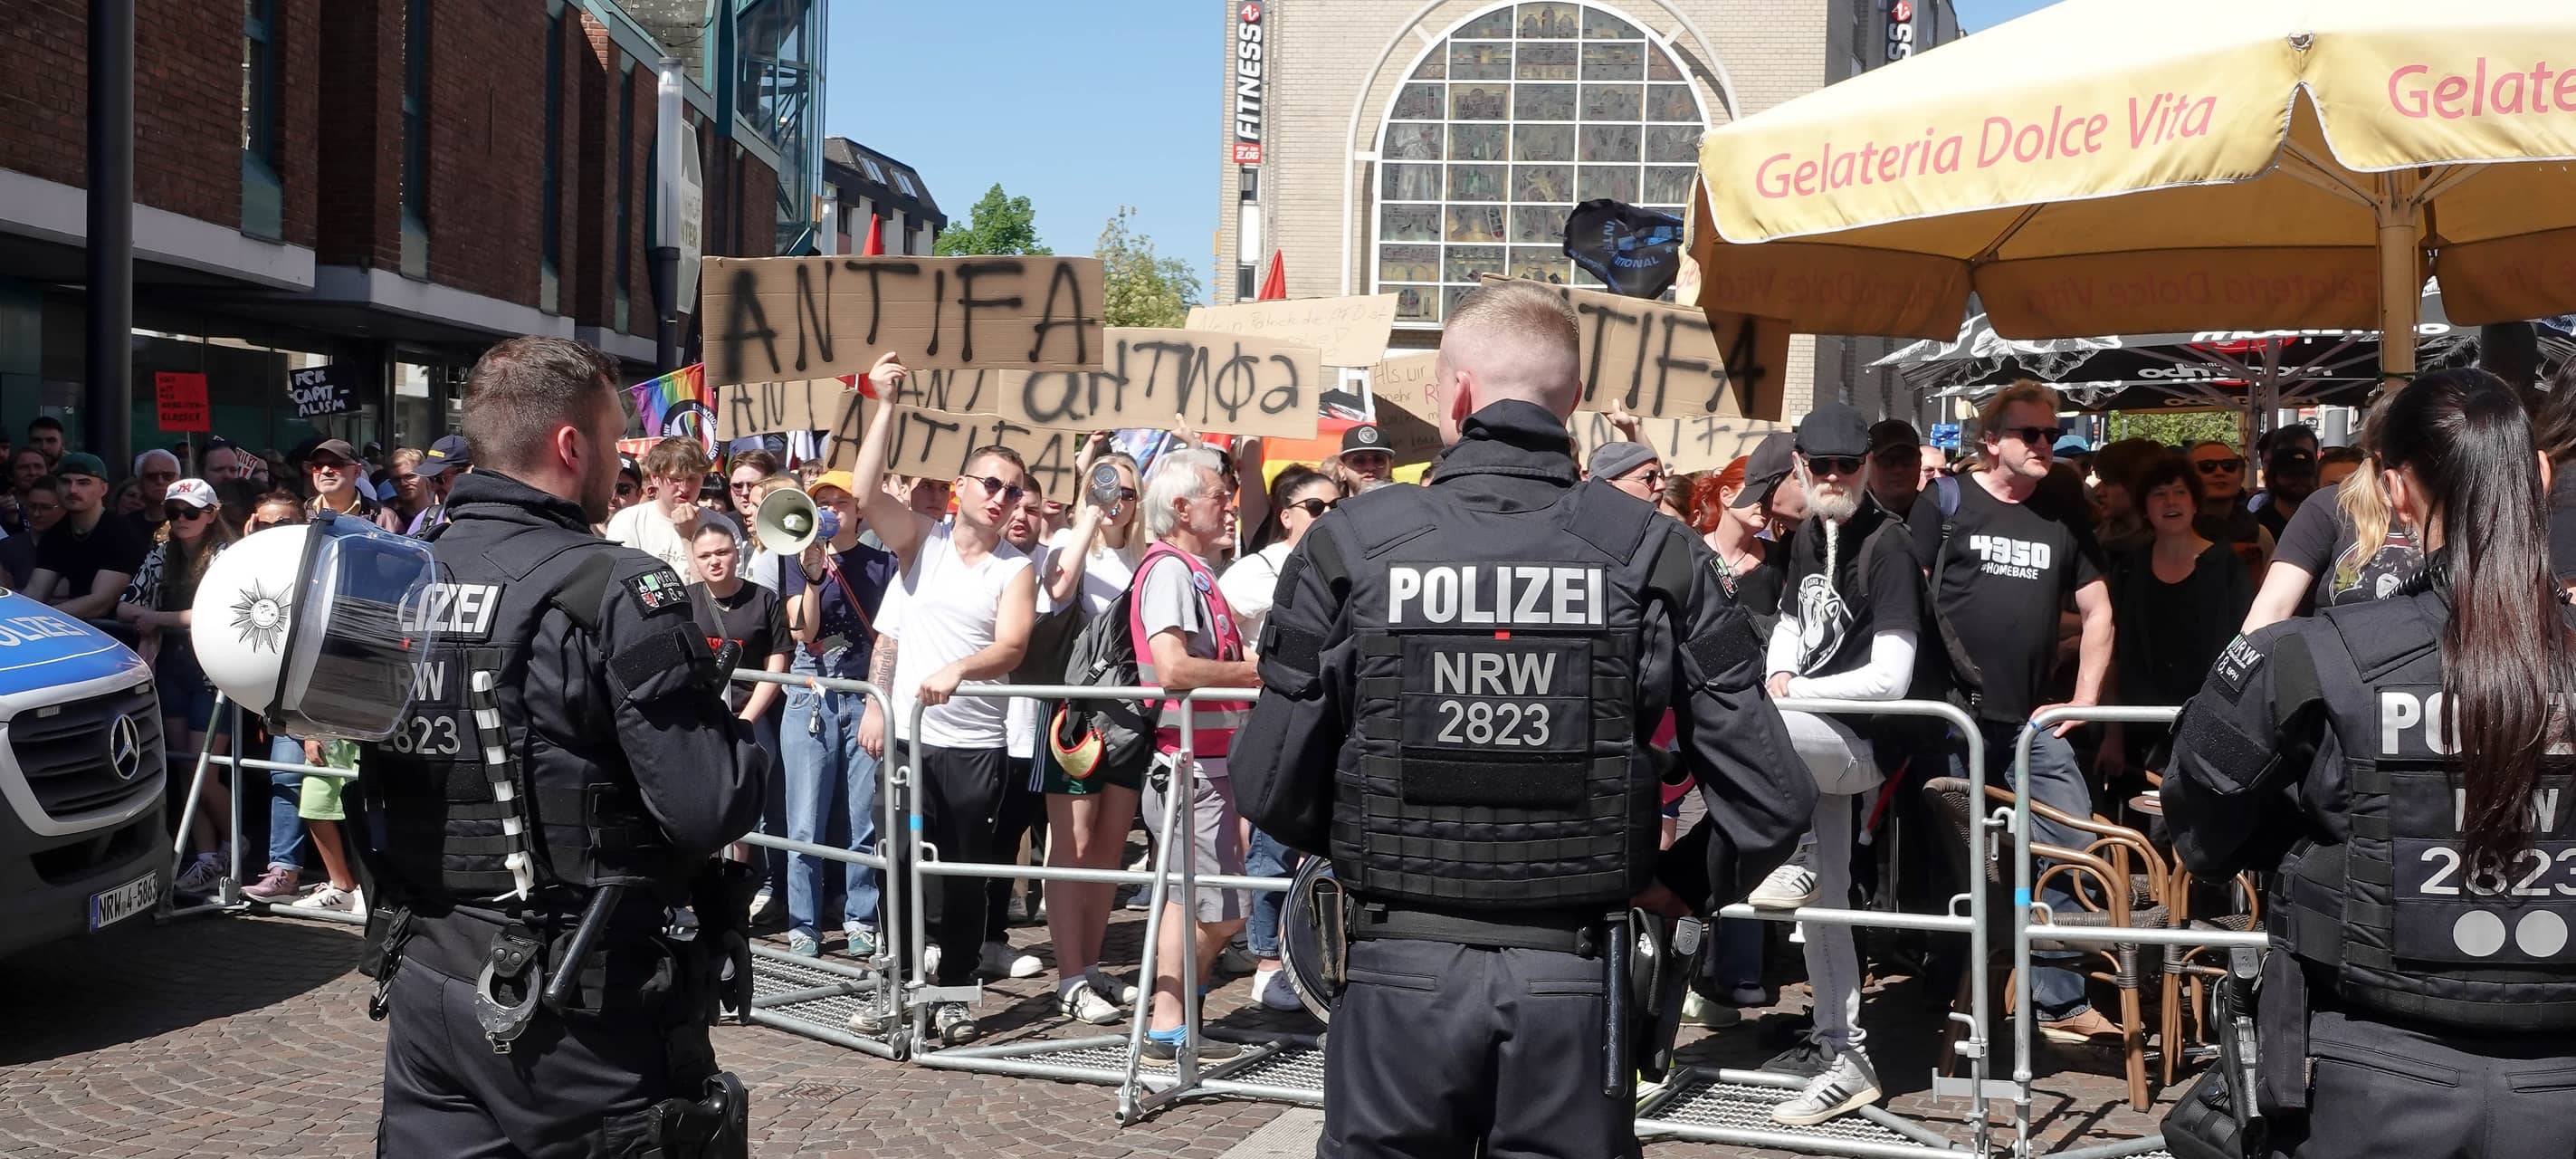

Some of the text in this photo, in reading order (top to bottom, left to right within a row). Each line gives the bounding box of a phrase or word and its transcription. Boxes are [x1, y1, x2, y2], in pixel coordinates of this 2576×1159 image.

[1236, 23, 1261, 139] FITNESS
[1757, 93, 2217, 198] Gelateria Dolce Vita
[721, 259, 1096, 382] ANTIFA
[1562, 290, 1766, 417] TIFA
[295, 369, 327, 386] FCK
[298, 399, 346, 417] ALISM
[1569, 412, 1781, 459] ANIFA
[1970, 534, 2050, 570] 4350
[1980, 561, 2039, 580] #HOMEBASE
[401, 582, 499, 632] IZEI
[1388, 566, 1603, 625] POLIZEI
[1434, 651, 1557, 695] NRW
[378, 715, 461, 755] 823
[1437, 700, 1550, 746] 2823
[99, 890, 122, 924] NRW
